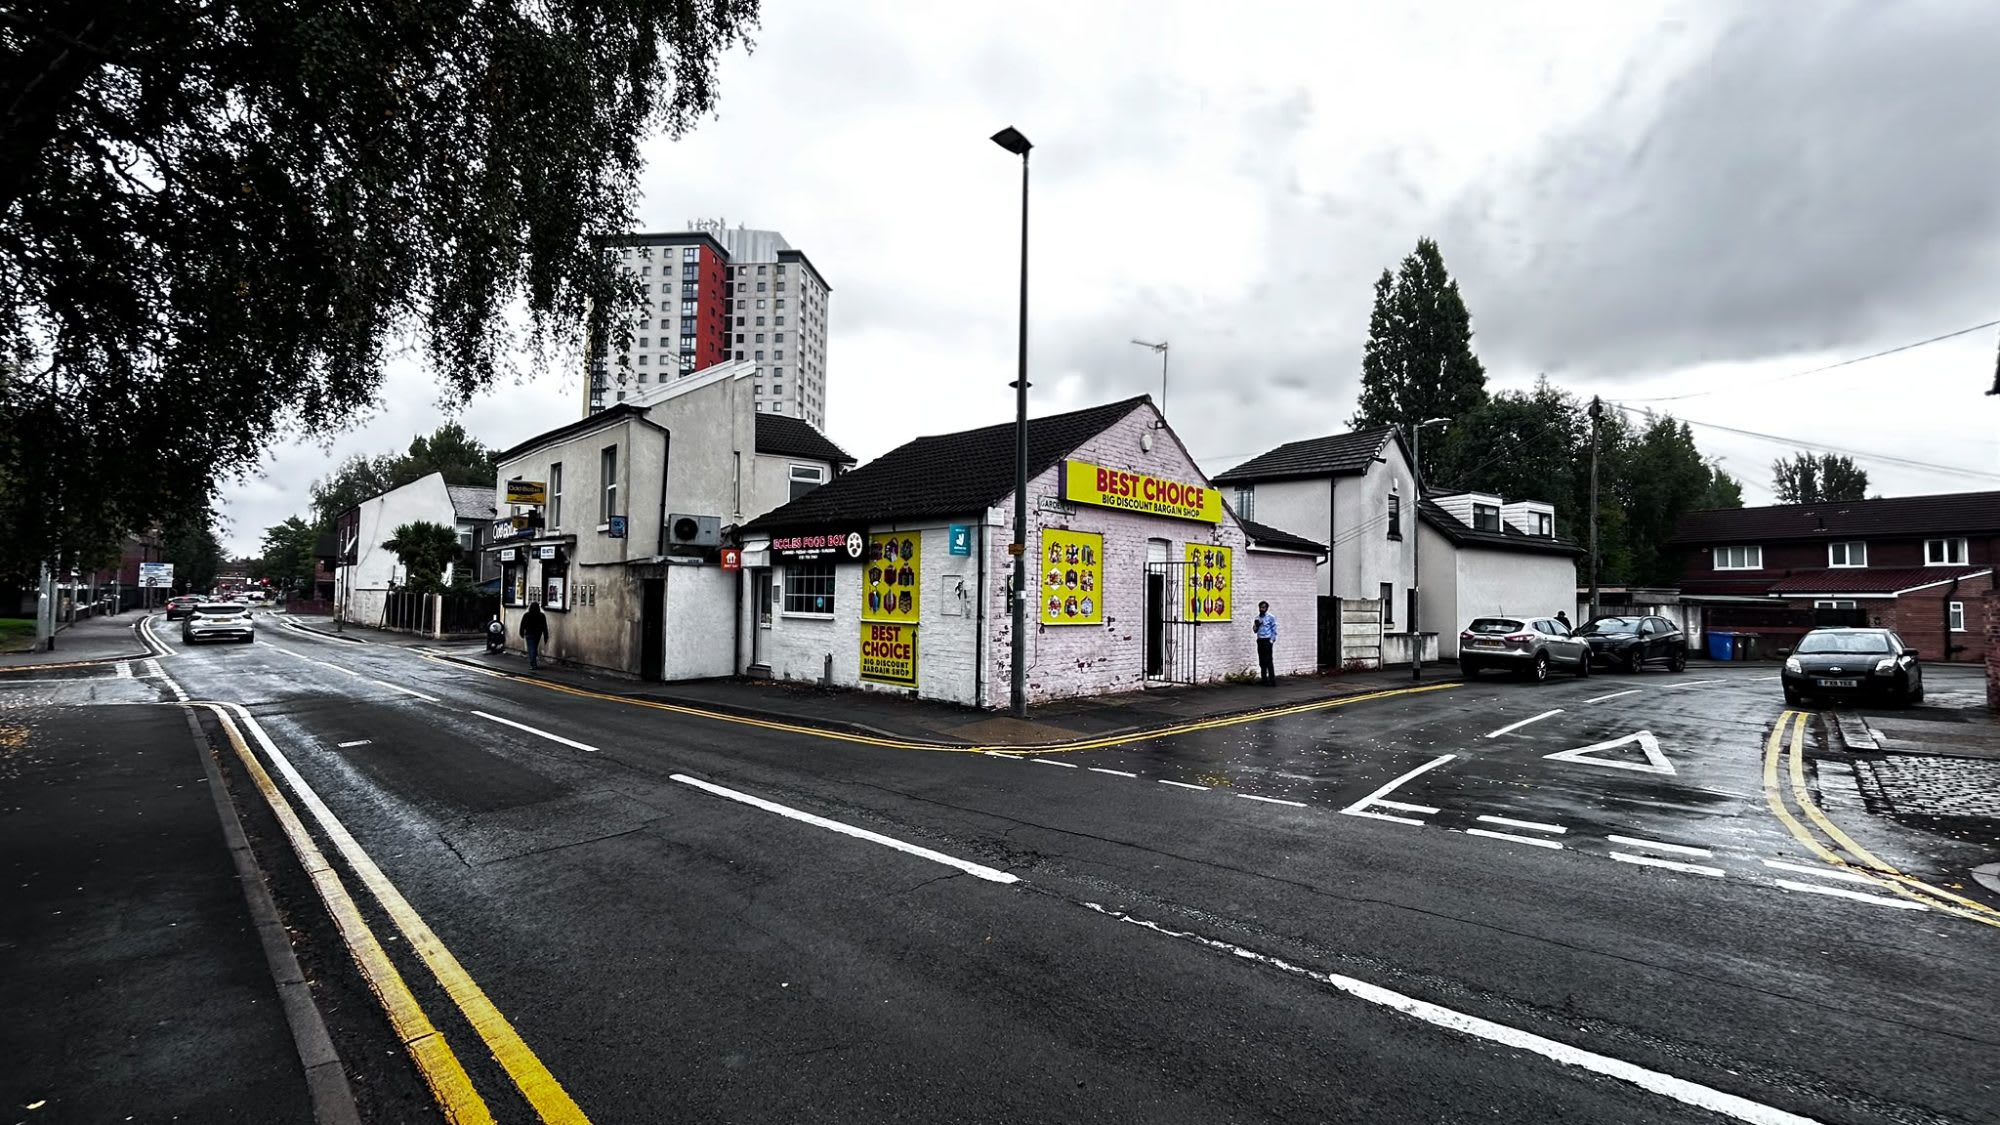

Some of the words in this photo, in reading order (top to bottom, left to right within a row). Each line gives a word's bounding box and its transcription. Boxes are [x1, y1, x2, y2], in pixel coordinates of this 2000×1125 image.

[1097, 468, 1139, 497] BEST
[1143, 478, 1204, 509] CHOICE
[1102, 494, 1115, 505] BIG
[1116, 496, 1152, 510] DISCOUNT
[1154, 503, 1182, 515] BARGAIN
[1183, 508, 1200, 517] SHOP
[773, 537, 801, 549] ECCLES
[803, 536, 825, 548] FOOD
[827, 534, 846, 546] BOX
[871, 625, 901, 642] BEST
[862, 641, 910, 660] CHOICE
[863, 665, 890, 674] BARGAIN
[891, 668, 909, 676] SHOP
[864, 658, 874, 666] BIG
[876, 659, 909, 668] DISCOUNT
